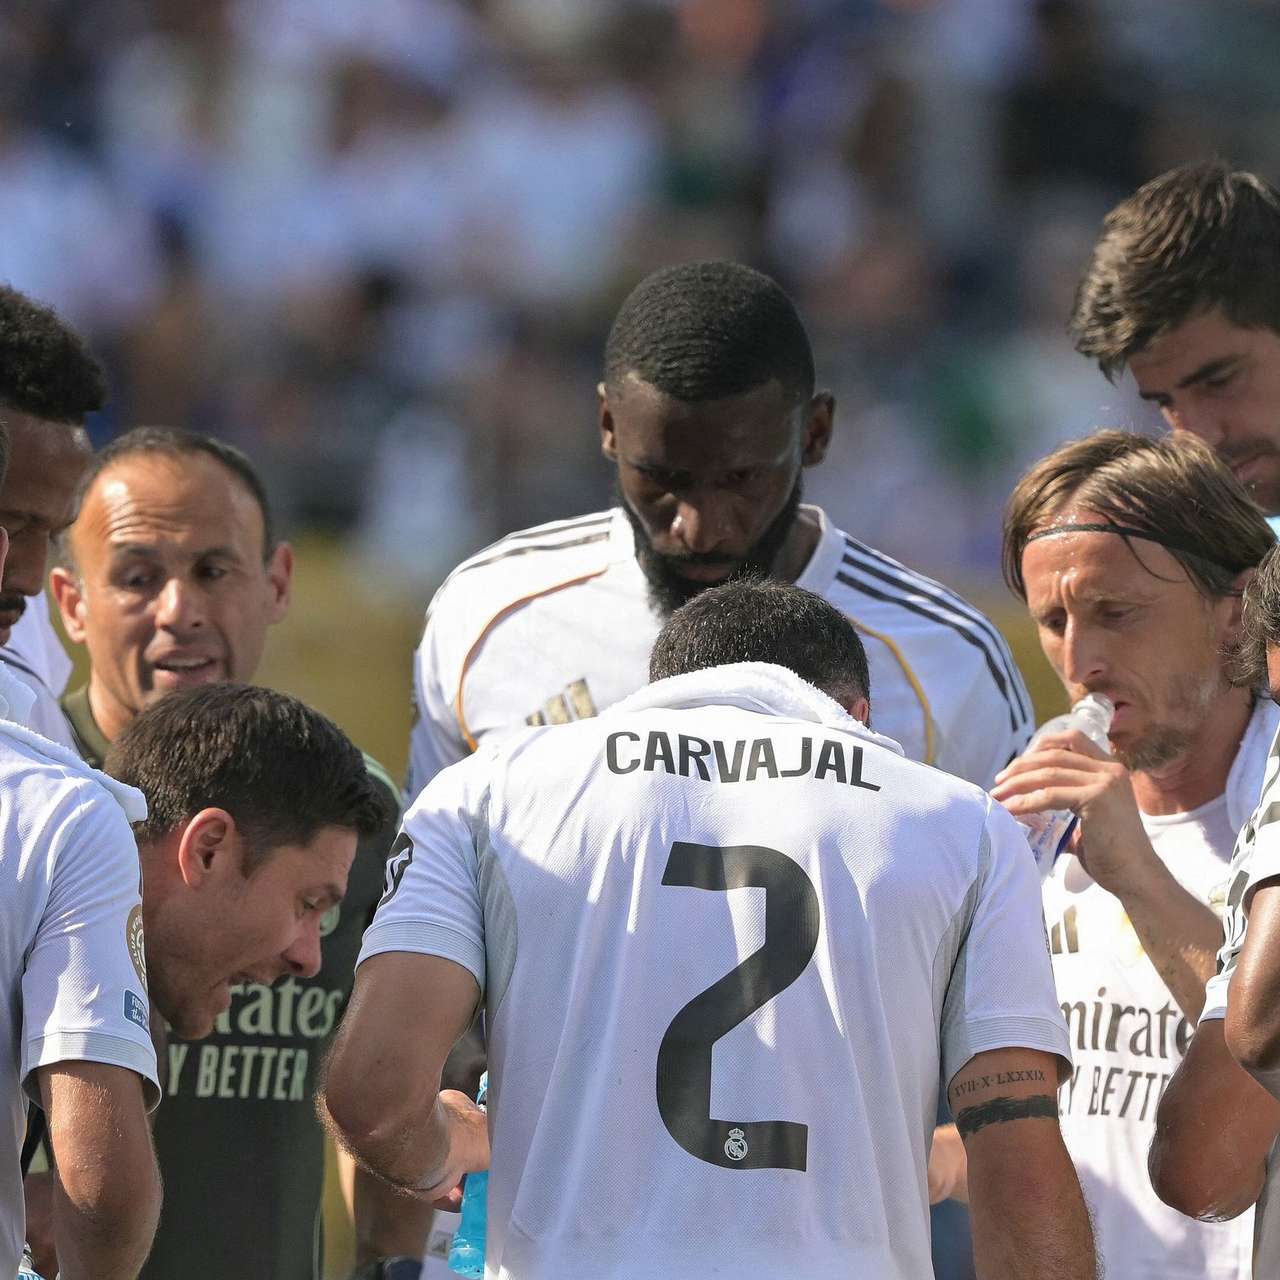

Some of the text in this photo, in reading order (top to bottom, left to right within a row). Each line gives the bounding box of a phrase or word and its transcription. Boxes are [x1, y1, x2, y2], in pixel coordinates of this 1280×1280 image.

[606, 730, 881, 791] CARVAJAL
[656, 842, 820, 1172] 2
[196, 1043, 309, 1101] BETTER
